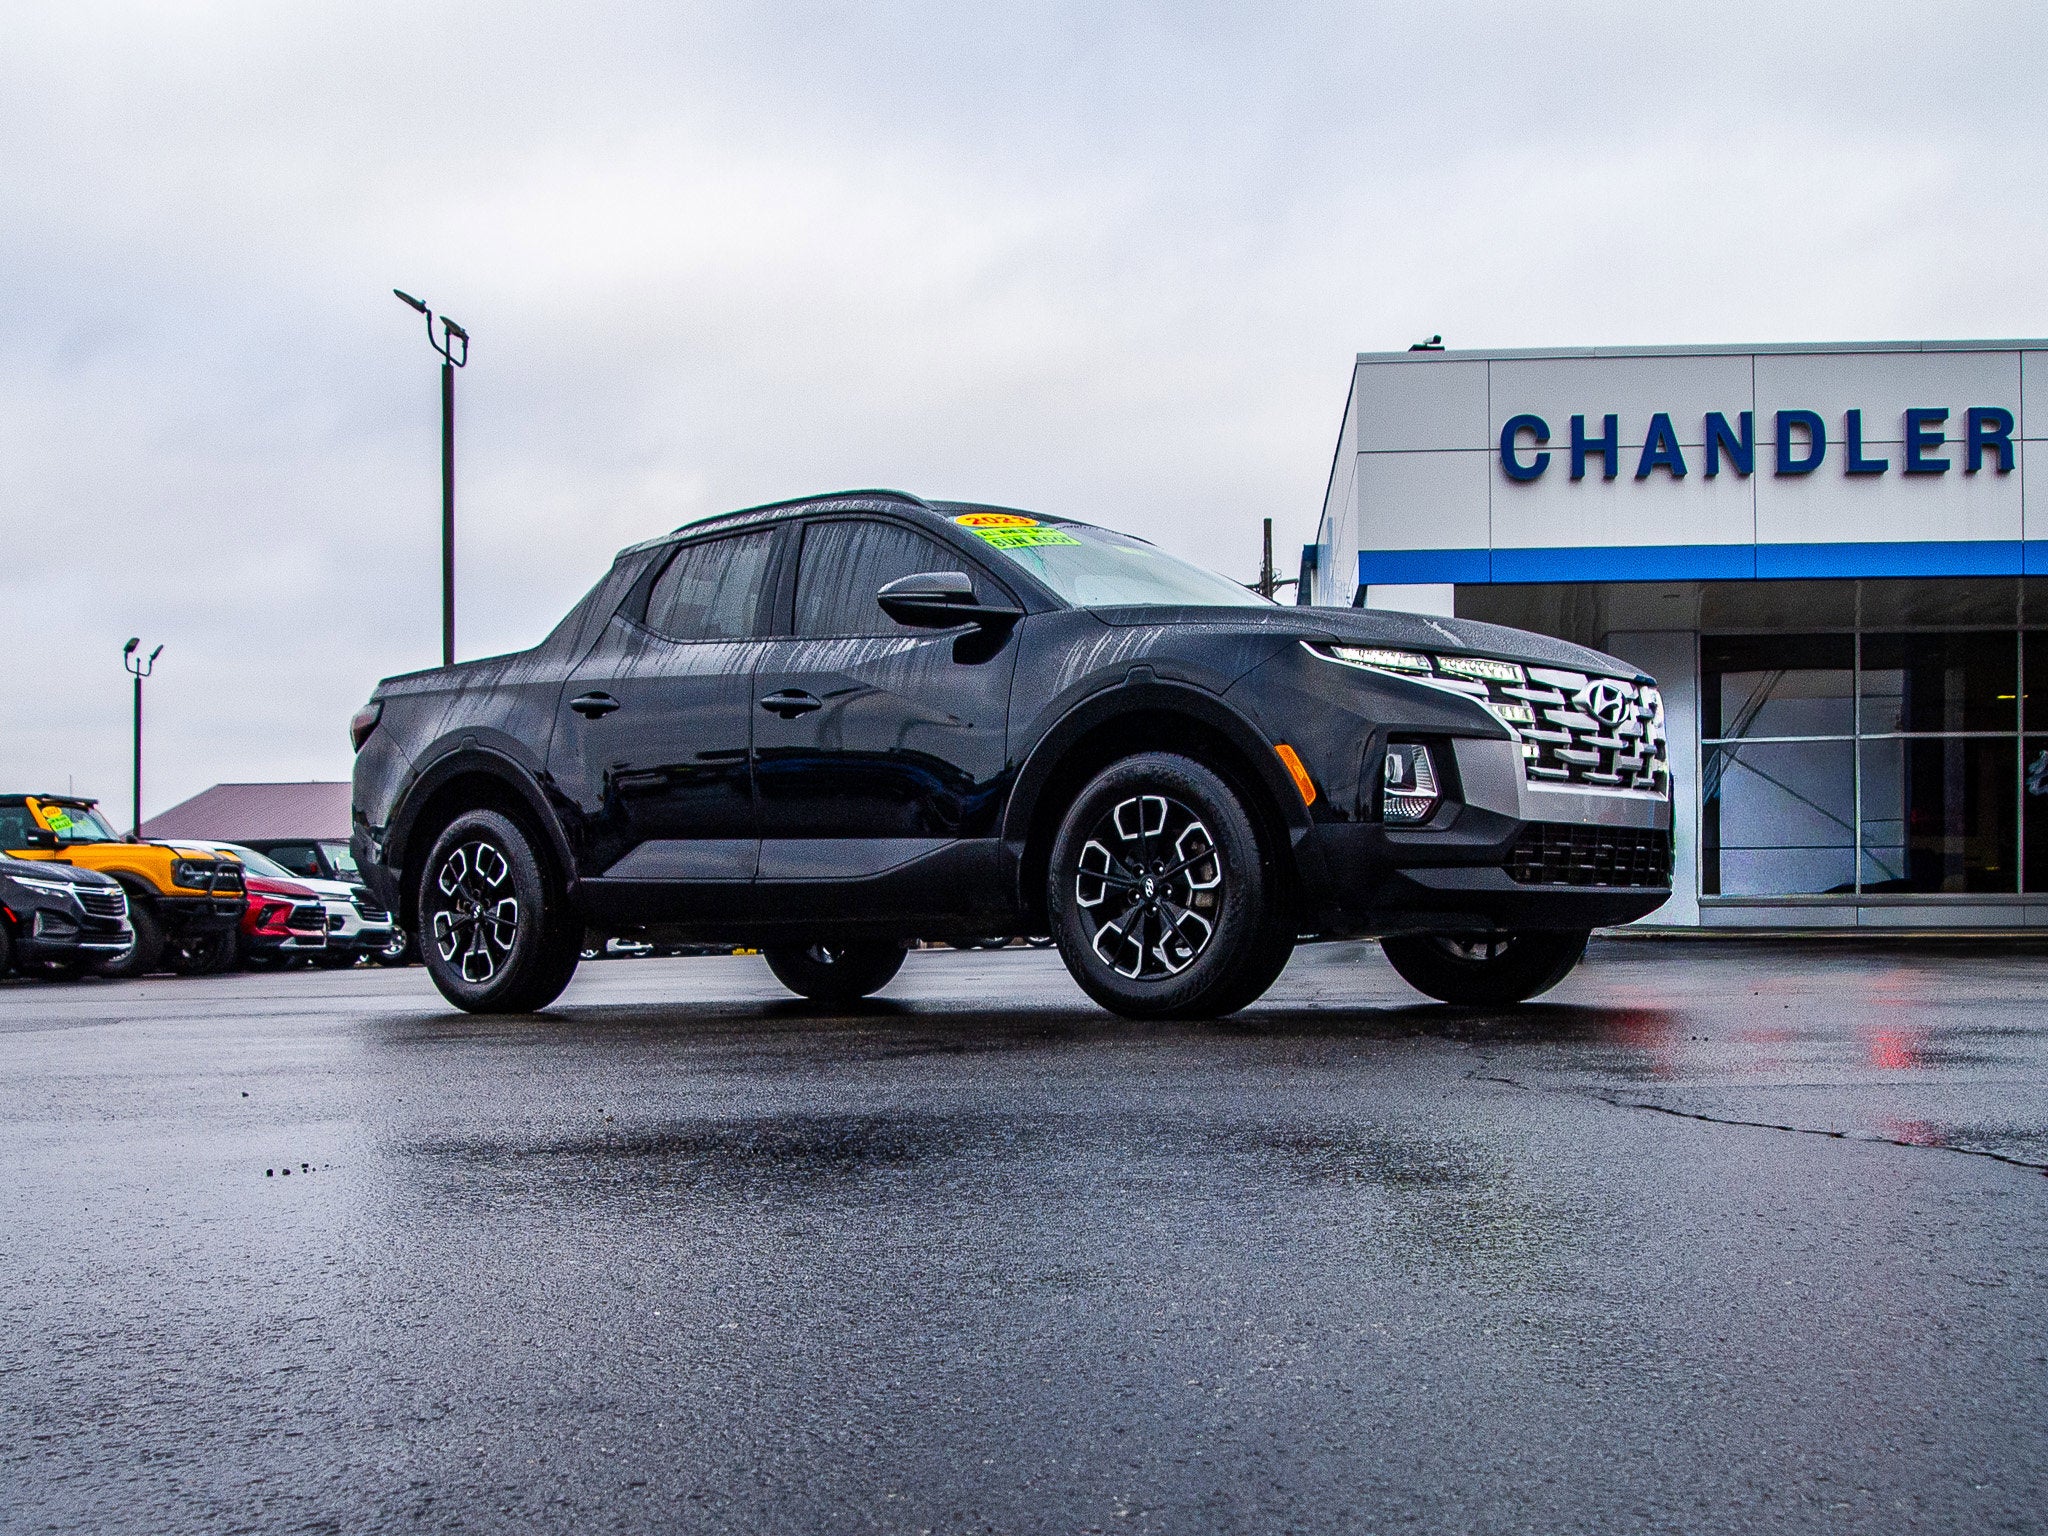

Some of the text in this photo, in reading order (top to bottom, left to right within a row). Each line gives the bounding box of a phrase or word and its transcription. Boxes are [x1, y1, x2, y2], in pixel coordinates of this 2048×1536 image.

[1499, 407, 2016, 479] CHANDLER
[966, 516, 1030, 525] 2023
[992, 535, 1072, 547] SUN ROOF
